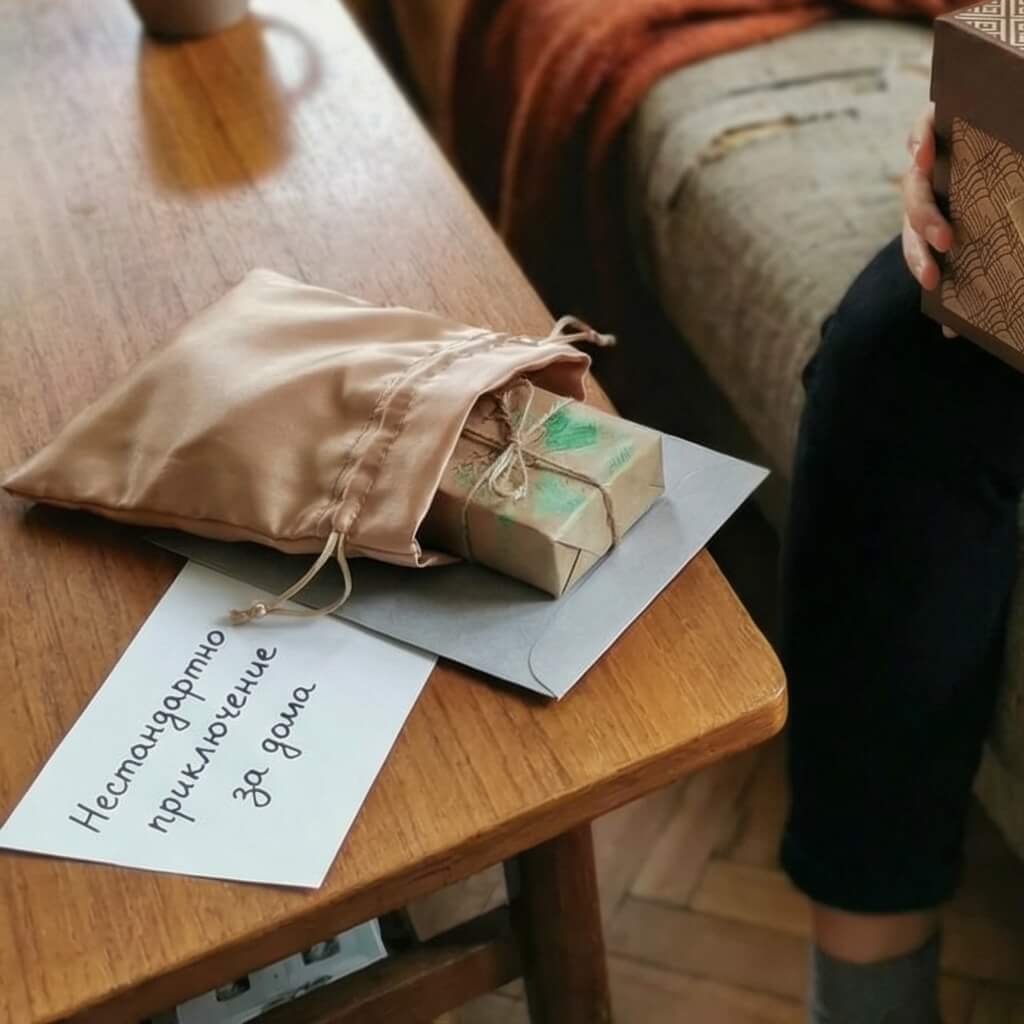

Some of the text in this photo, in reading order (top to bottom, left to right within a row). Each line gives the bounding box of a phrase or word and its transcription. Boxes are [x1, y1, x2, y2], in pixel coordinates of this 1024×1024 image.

[68, 629, 226, 834] Нестандартно
[148, 646, 278, 835] приключение
[232, 682, 317, 809] за дома
